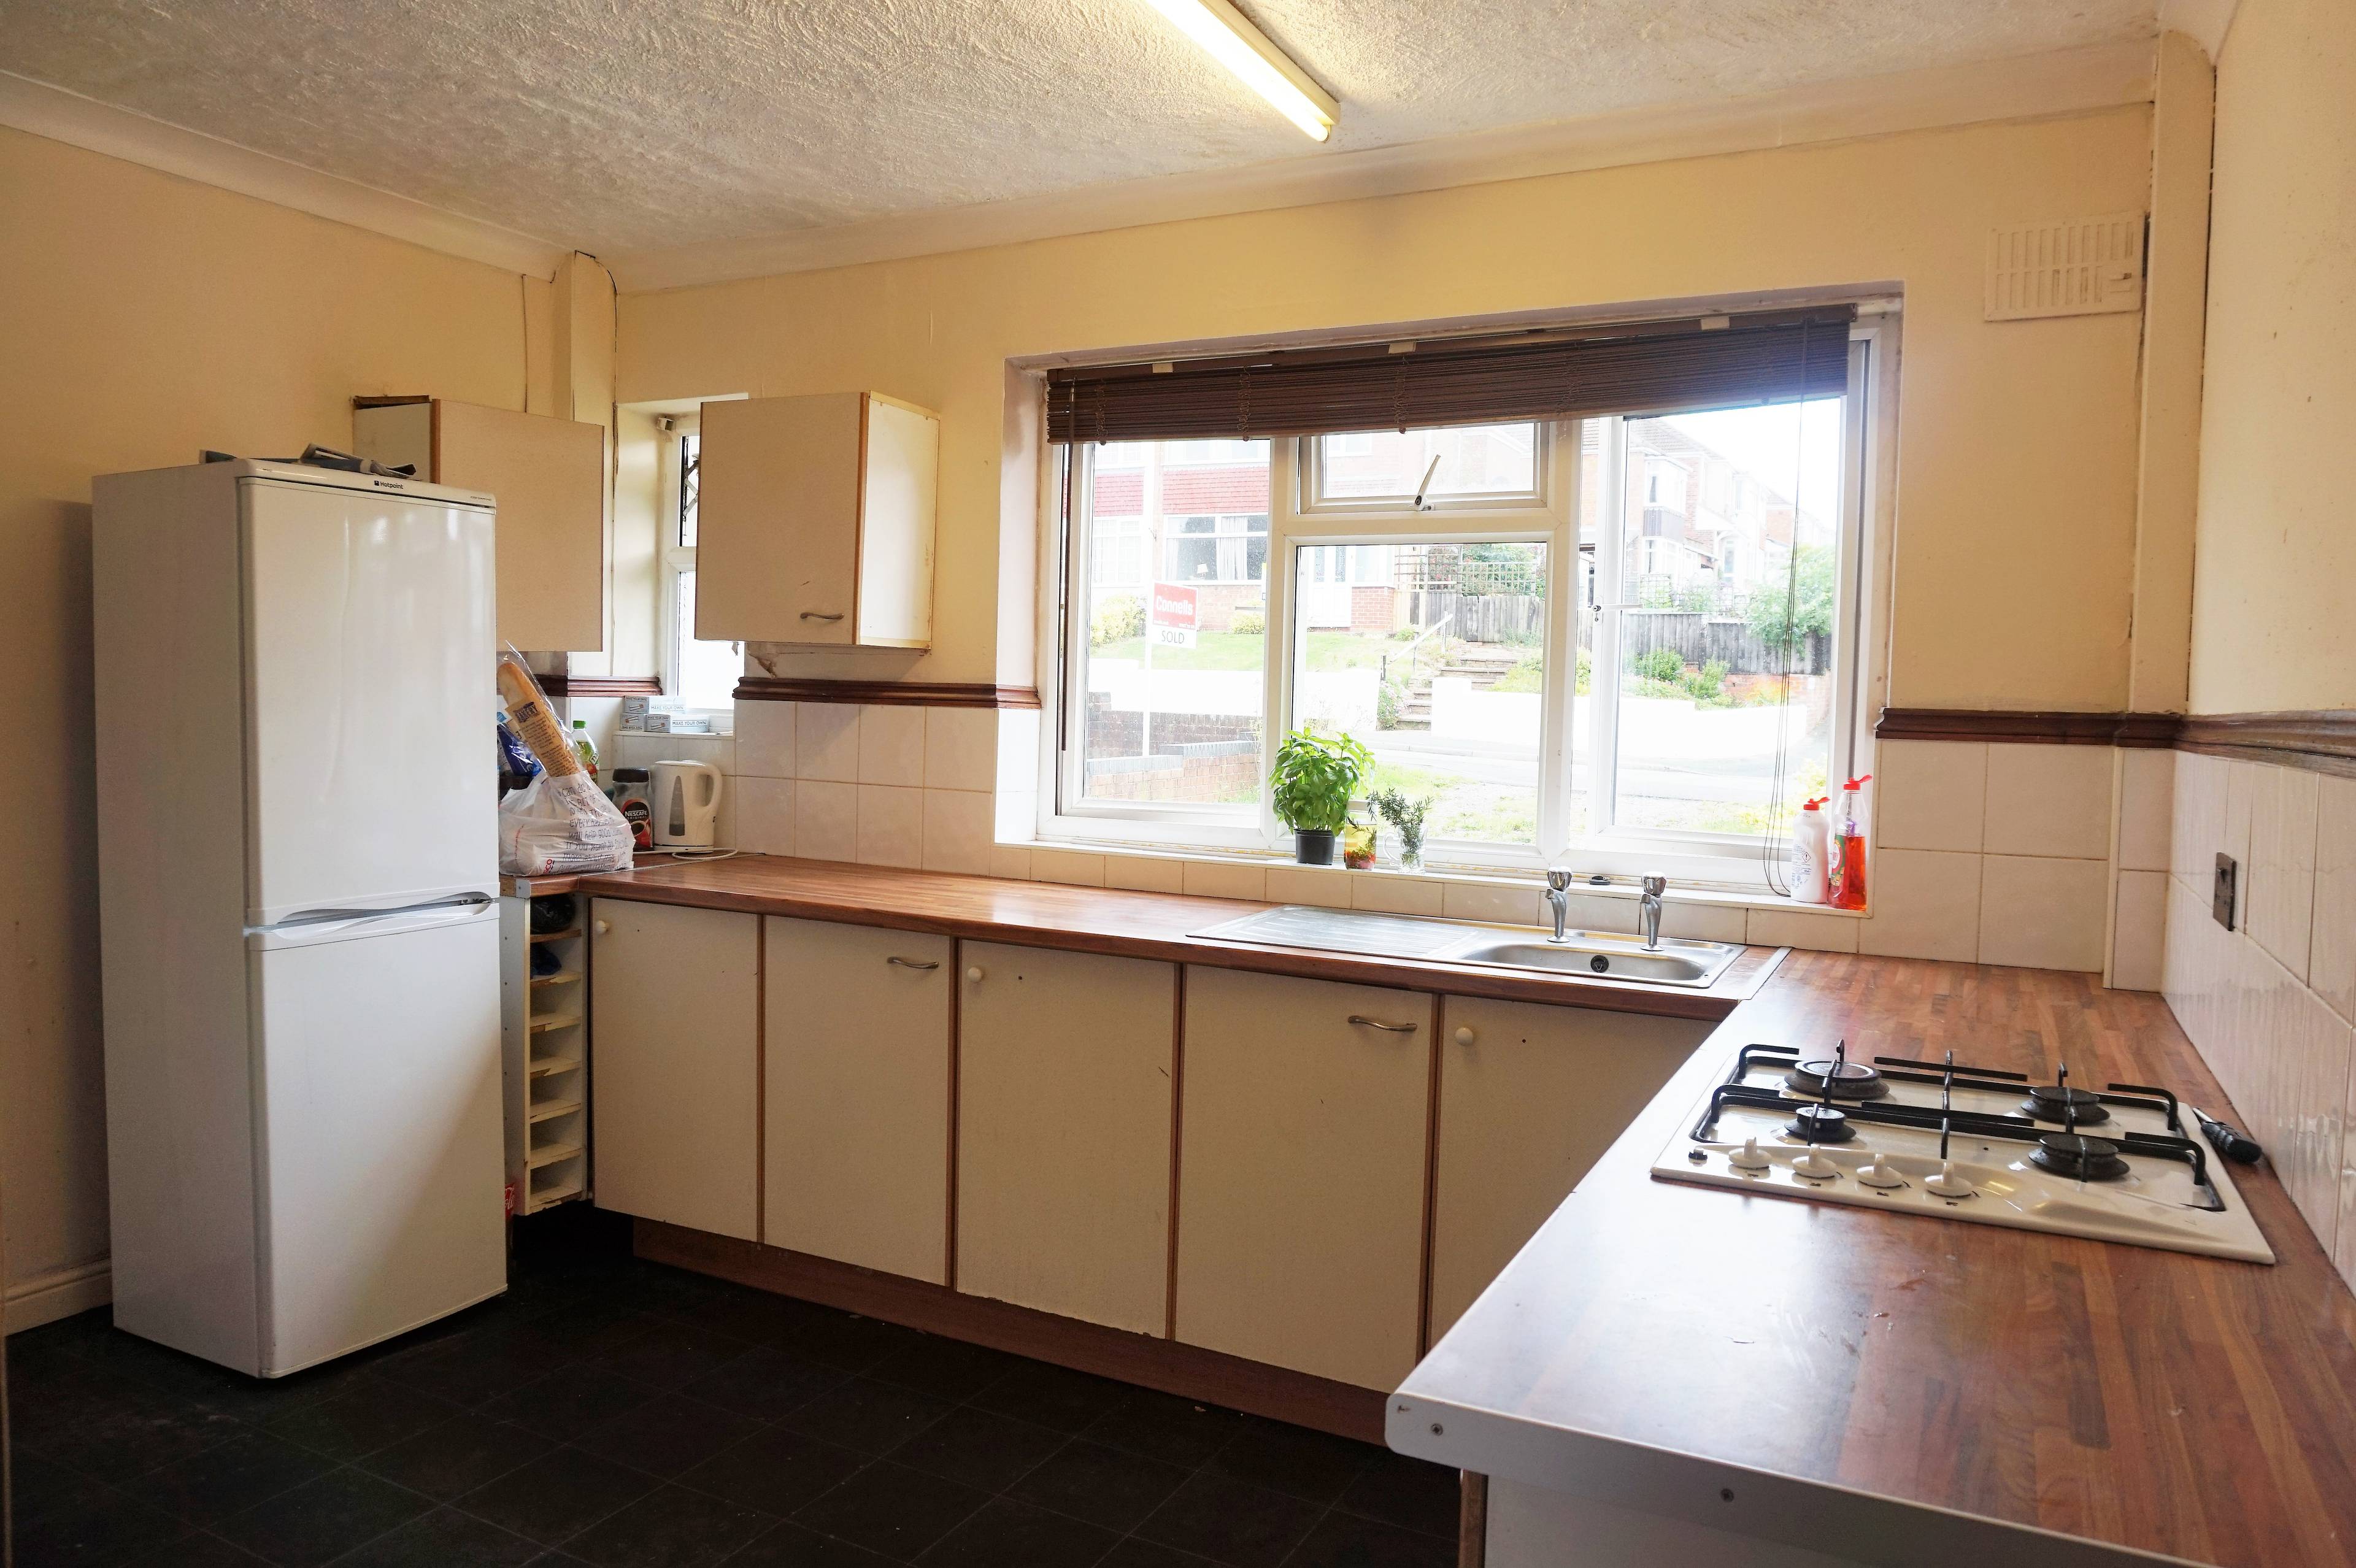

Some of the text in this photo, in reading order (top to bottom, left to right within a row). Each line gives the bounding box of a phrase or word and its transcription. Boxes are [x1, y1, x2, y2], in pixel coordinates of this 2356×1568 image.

[380, 481, 404, 490] Hotpoint
[1156, 595, 1193, 615] Connells
[1161, 630, 1185, 644] SOLD
